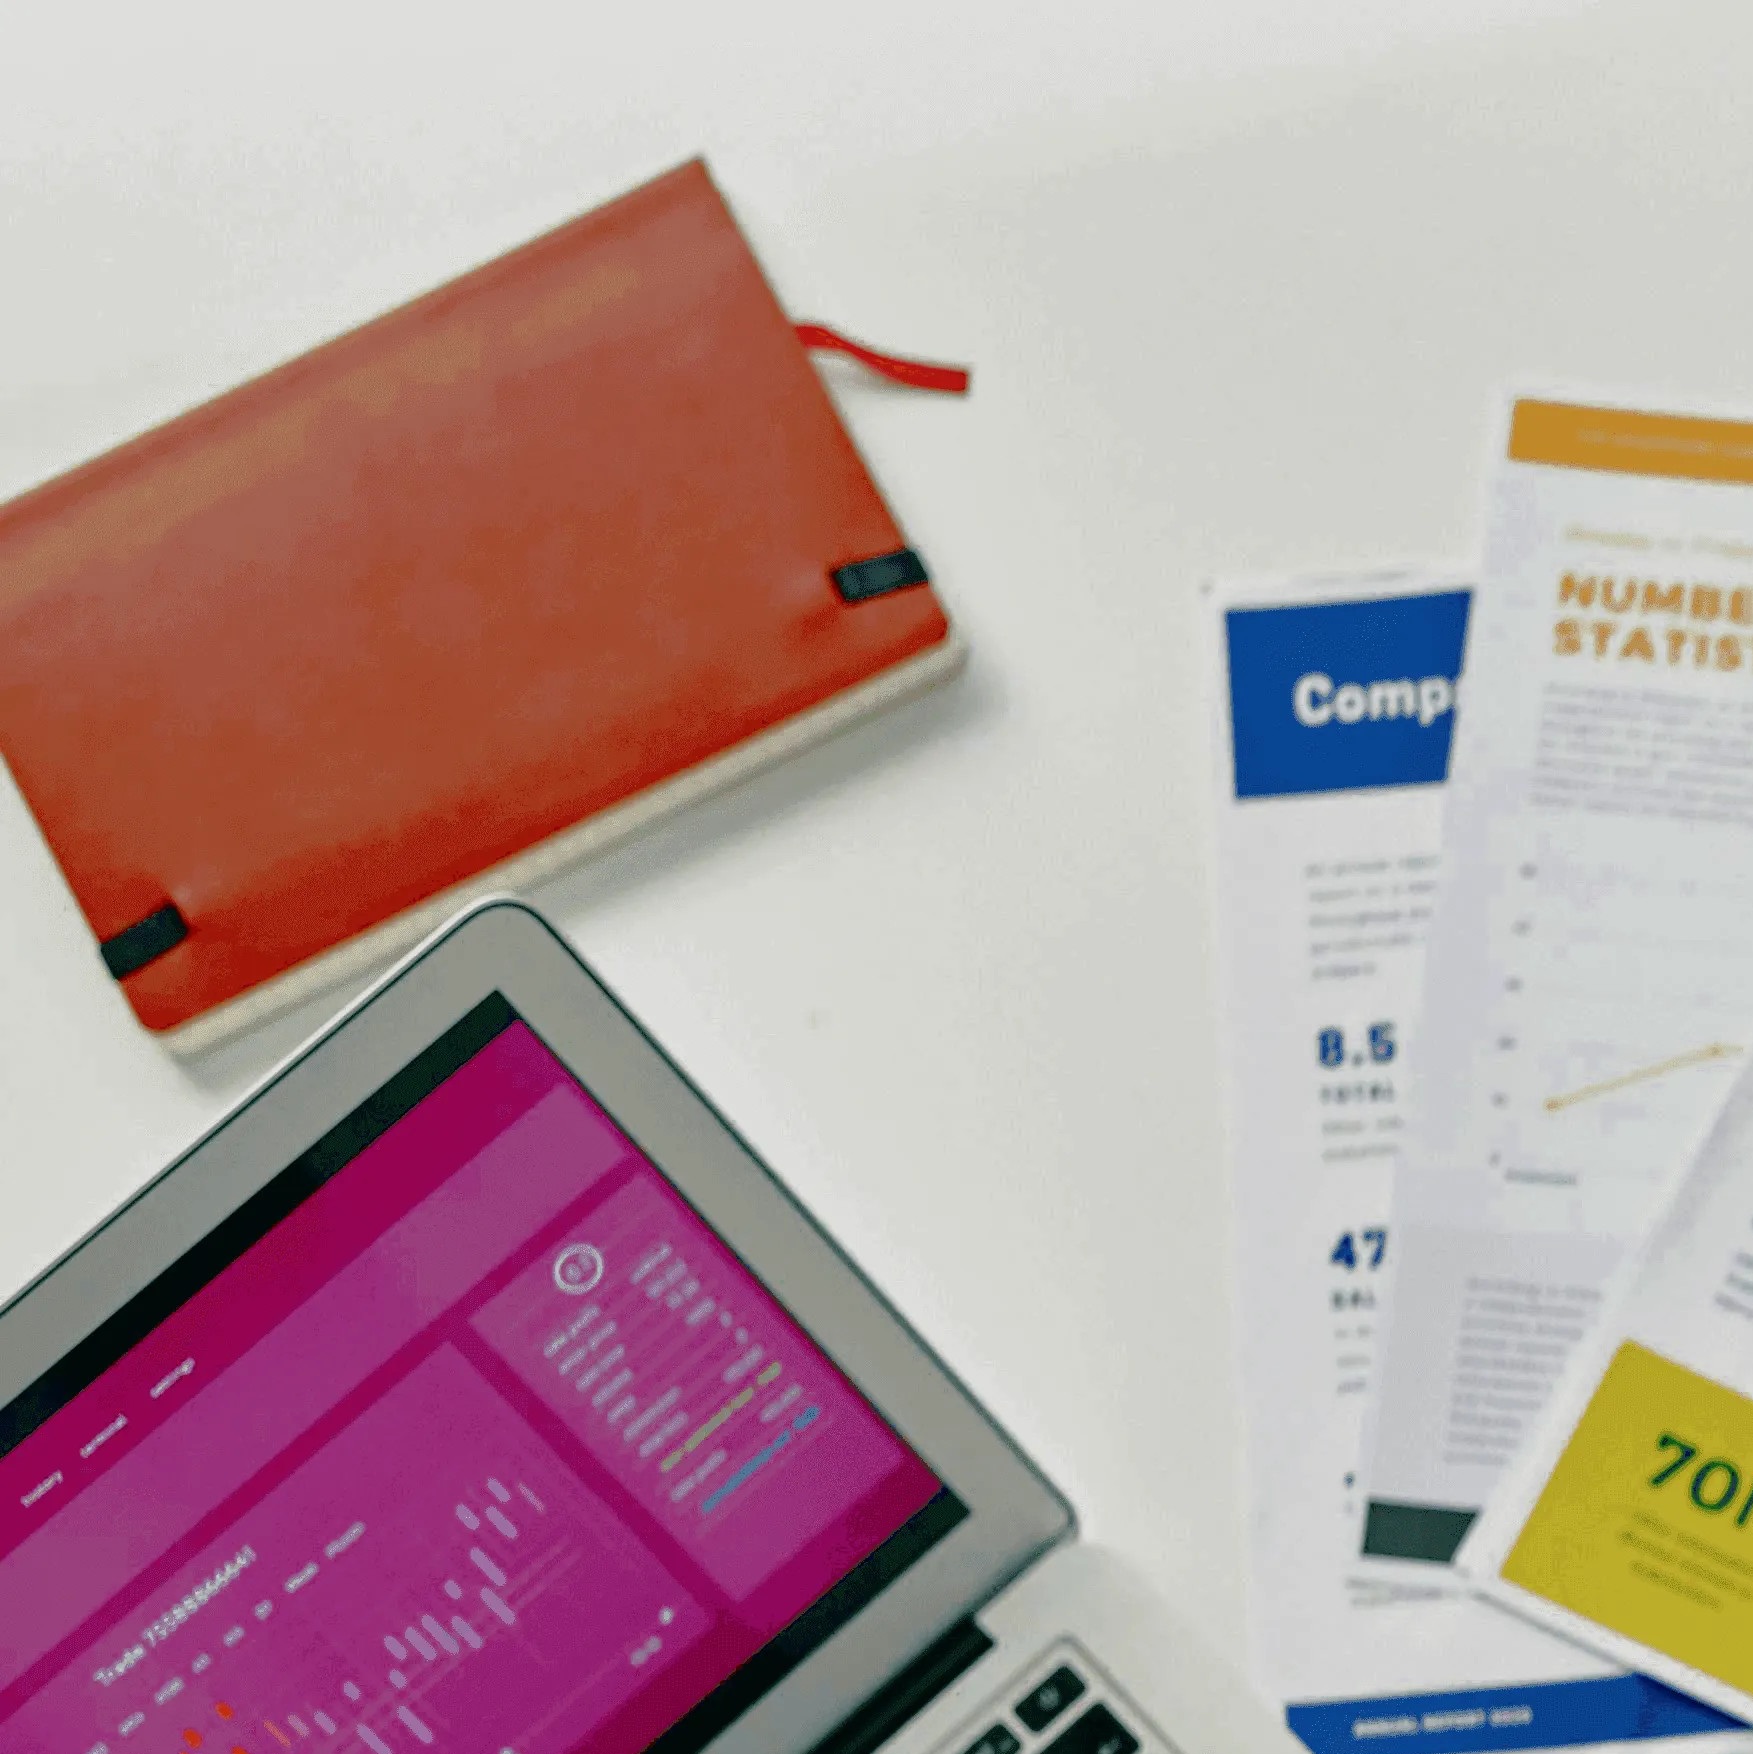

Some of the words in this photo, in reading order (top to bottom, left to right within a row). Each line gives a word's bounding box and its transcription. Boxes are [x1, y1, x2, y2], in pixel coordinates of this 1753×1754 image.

[1292, 670, 1458, 728] Comp
[1317, 1021, 1398, 1069] 8.5
[1329, 1226, 1389, 1271] 47
[93, 1643, 146, 1686] Trade
